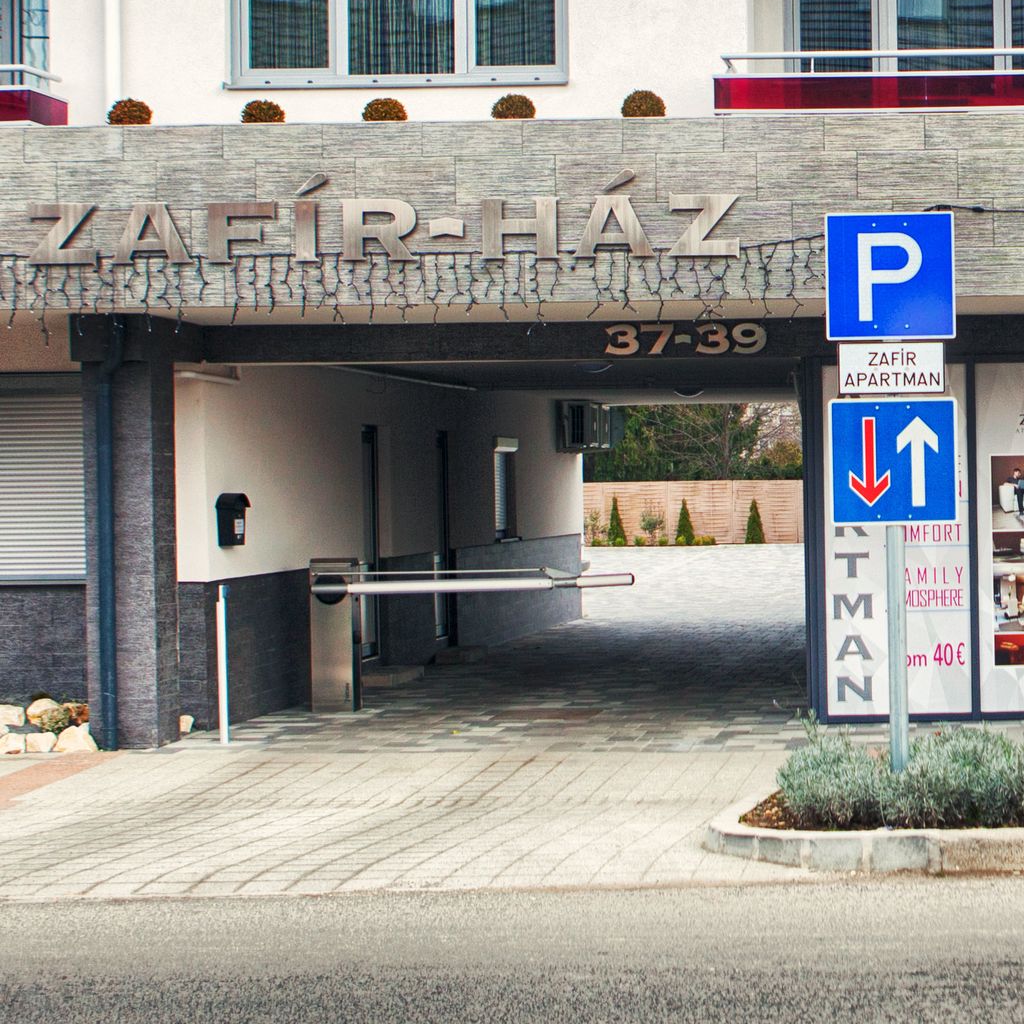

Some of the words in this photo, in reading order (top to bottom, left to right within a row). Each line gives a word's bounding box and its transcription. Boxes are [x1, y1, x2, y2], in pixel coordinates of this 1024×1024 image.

[27, 169, 741, 265] ZAFÍR-HÁZ
[857, 232, 922, 321] P
[605, 322, 767, 355] 37-39
[844, 372, 940, 387] APARTMAN
[904, 524, 962, 542] MFORT
[905, 566, 963, 585] AMILY
